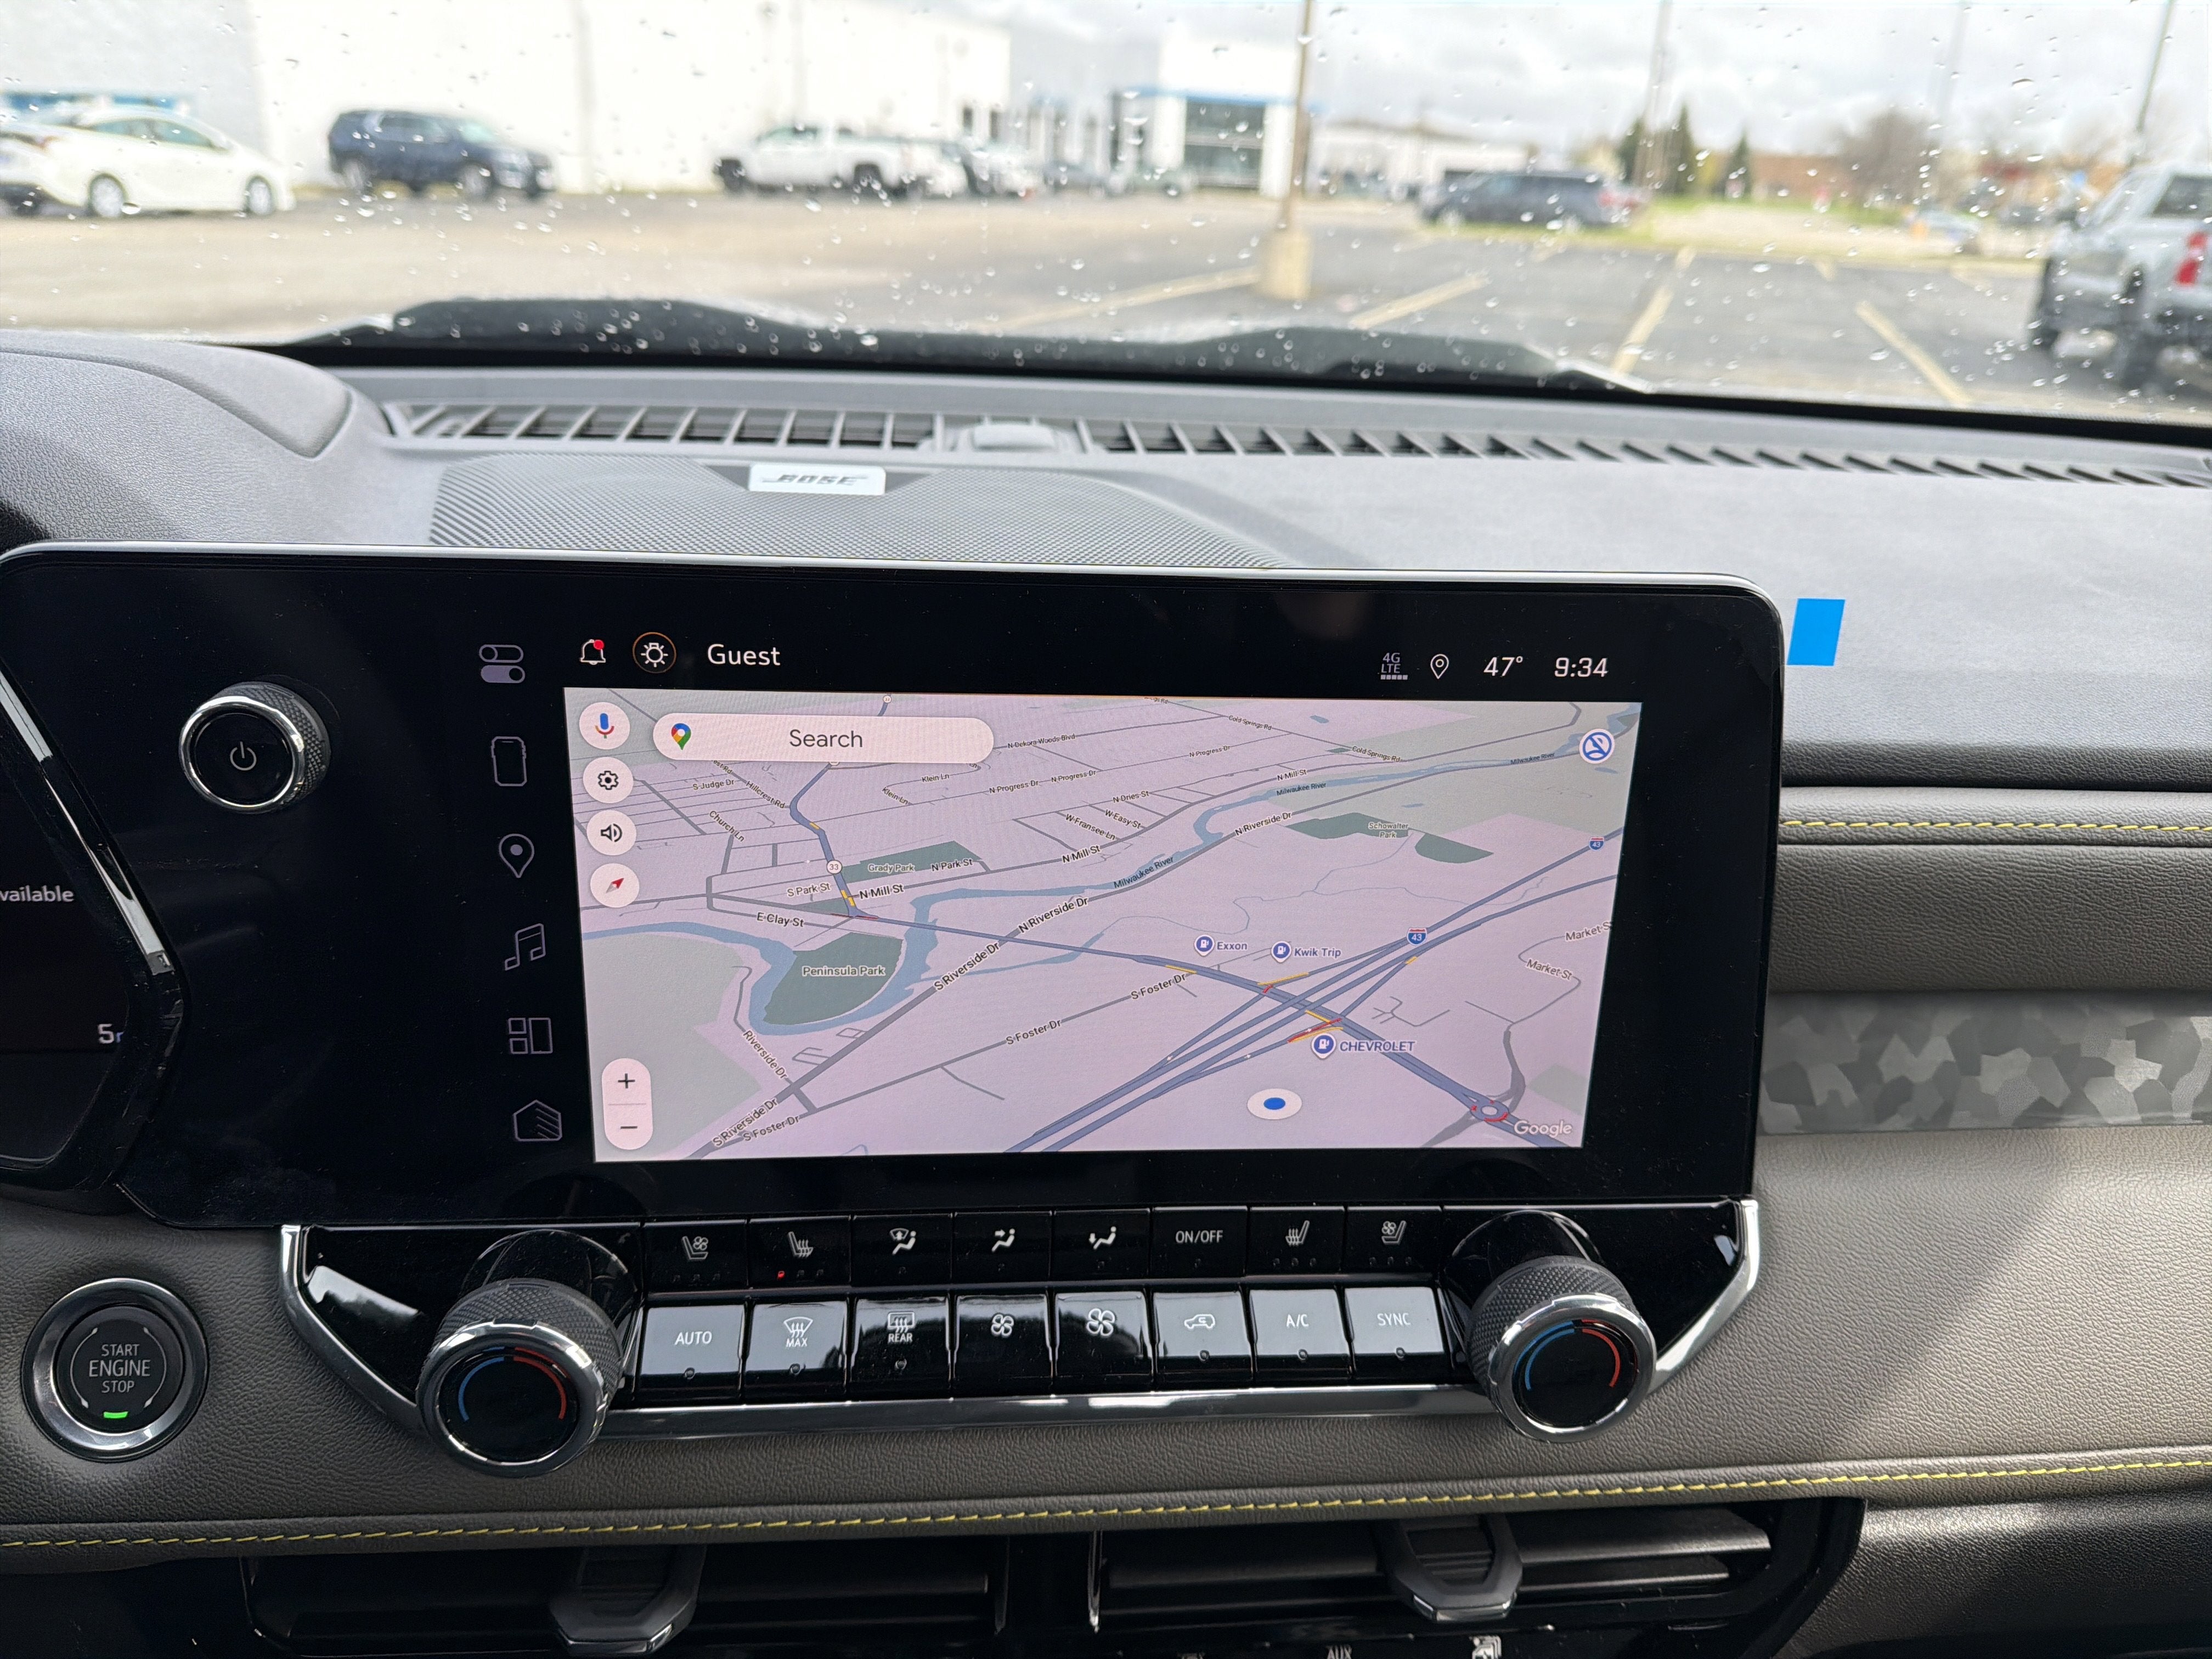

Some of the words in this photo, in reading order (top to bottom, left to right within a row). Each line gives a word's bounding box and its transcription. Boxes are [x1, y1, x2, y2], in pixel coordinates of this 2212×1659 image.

[708, 644, 780, 665] Guest
[1383, 652, 1401, 663] 4G
[1381, 664, 1401, 673] LTE
[1483, 656, 1523, 676] 47°
[1554, 658, 1608, 678] 9:34
[1229, 715, 1241, 723] Cold
[1242, 718, 1263, 729] Springs
[789, 729, 863, 748] Search
[1352, 746, 1366, 754] Cold
[1367, 749, 1390, 760] Springs
[1510, 755, 1540, 765] Milwaukee
[723, 765, 732, 774] Rd
[1058, 771, 1087, 781] Progress
[1285, 771, 1297, 779] Mill
[700, 780, 724, 789] Judge
[997, 782, 1029, 792] Progress
[1277, 785, 1310, 796] Milwaukee
[746, 781, 774, 804] Hillcrest
[774, 799, 786, 809] Rd
[882, 787, 898, 800] Klein
[899, 797, 909, 805] Ln
[1121, 793, 1139, 802] Dries
[709, 811, 735, 834] Church
[735, 831, 744, 842] Ln
[1065, 814, 1073, 822] W
[1075, 818, 1104, 836] Fransee
[1105, 831, 1115, 840] Ln
[1114, 814, 1131, 826] Easy
[1235, 827, 1243, 836] N
[1244, 816, 1280, 832] Riverside
[1282, 812, 1291, 820] Dr
[1062, 855, 1070, 863] N
[1071, 849, 1089, 860] Mill
[1090, 845, 1101, 855] St
[868, 864, 894, 873] Grady
[941, 860, 961, 870] Park
[1114, 866, 1154, 889] Milwaukee
[1154, 856, 1174, 870] River
[797, 885, 818, 895] Park
[819, 883, 831, 891] St
[860, 891, 867, 899] N
[871, 886, 890, 897] Mill
[757, 912, 764, 921] E
[767, 913, 789, 927] Clay
[792, 917, 804, 927] St
[1019, 923, 1029, 933] N
[1028, 902, 1074, 927] Riverside
[1076, 897, 1088, 907] Dr
[1566, 926, 1601, 940] Market
[1217, 941, 1248, 951] Exxon
[1294, 947, 1320, 957] Kwik
[1322, 948, 1341, 960] Trip
[803, 966, 857, 976] Peninsula
[860, 966, 886, 975] Park
[934, 981, 944, 990] S
[943, 951, 988, 985] Riverside
[987, 941, 1000, 954] Dr
[1527, 959, 1558, 976] Market
[1561, 969, 1572, 980] St
[1131, 991, 1139, 1000] S
[1141, 979, 1173, 996] Foster
[1174, 973, 1187, 984] Dr
[1006, 1036, 1014, 1045] S
[1015, 1025, 1047, 1042] Foster
[1049, 1020, 1062, 1029] Dr
[1340, 1041, 1415, 1052] CHEVROLET
[743, 1030, 777, 1070] Riverside
[775, 1067, 787, 1080] Dr
[713, 1137, 722, 1146] S
[720, 1107, 766, 1141] Riverside
[764, 1098, 778, 1110] Dr
[743, 1132, 752, 1141] S
[753, 1121, 786, 1138] Foster
[787, 1115, 800, 1125] Dr
[1514, 1121, 1572, 1138] Google
[1176, 1230, 1223, 1244] ON/OFF
[1286, 1314, 1309, 1328] A/C
[1377, 1313, 1411, 1327] SYNC
[675, 1331, 712, 1346] AUTO
[786, 1338, 808, 1347] MAX
[888, 1333, 913, 1343] REAR
[101, 1344, 140, 1356] START
[89, 1359, 151, 1377] ENGINE
[101, 1380, 135, 1393] STOP
